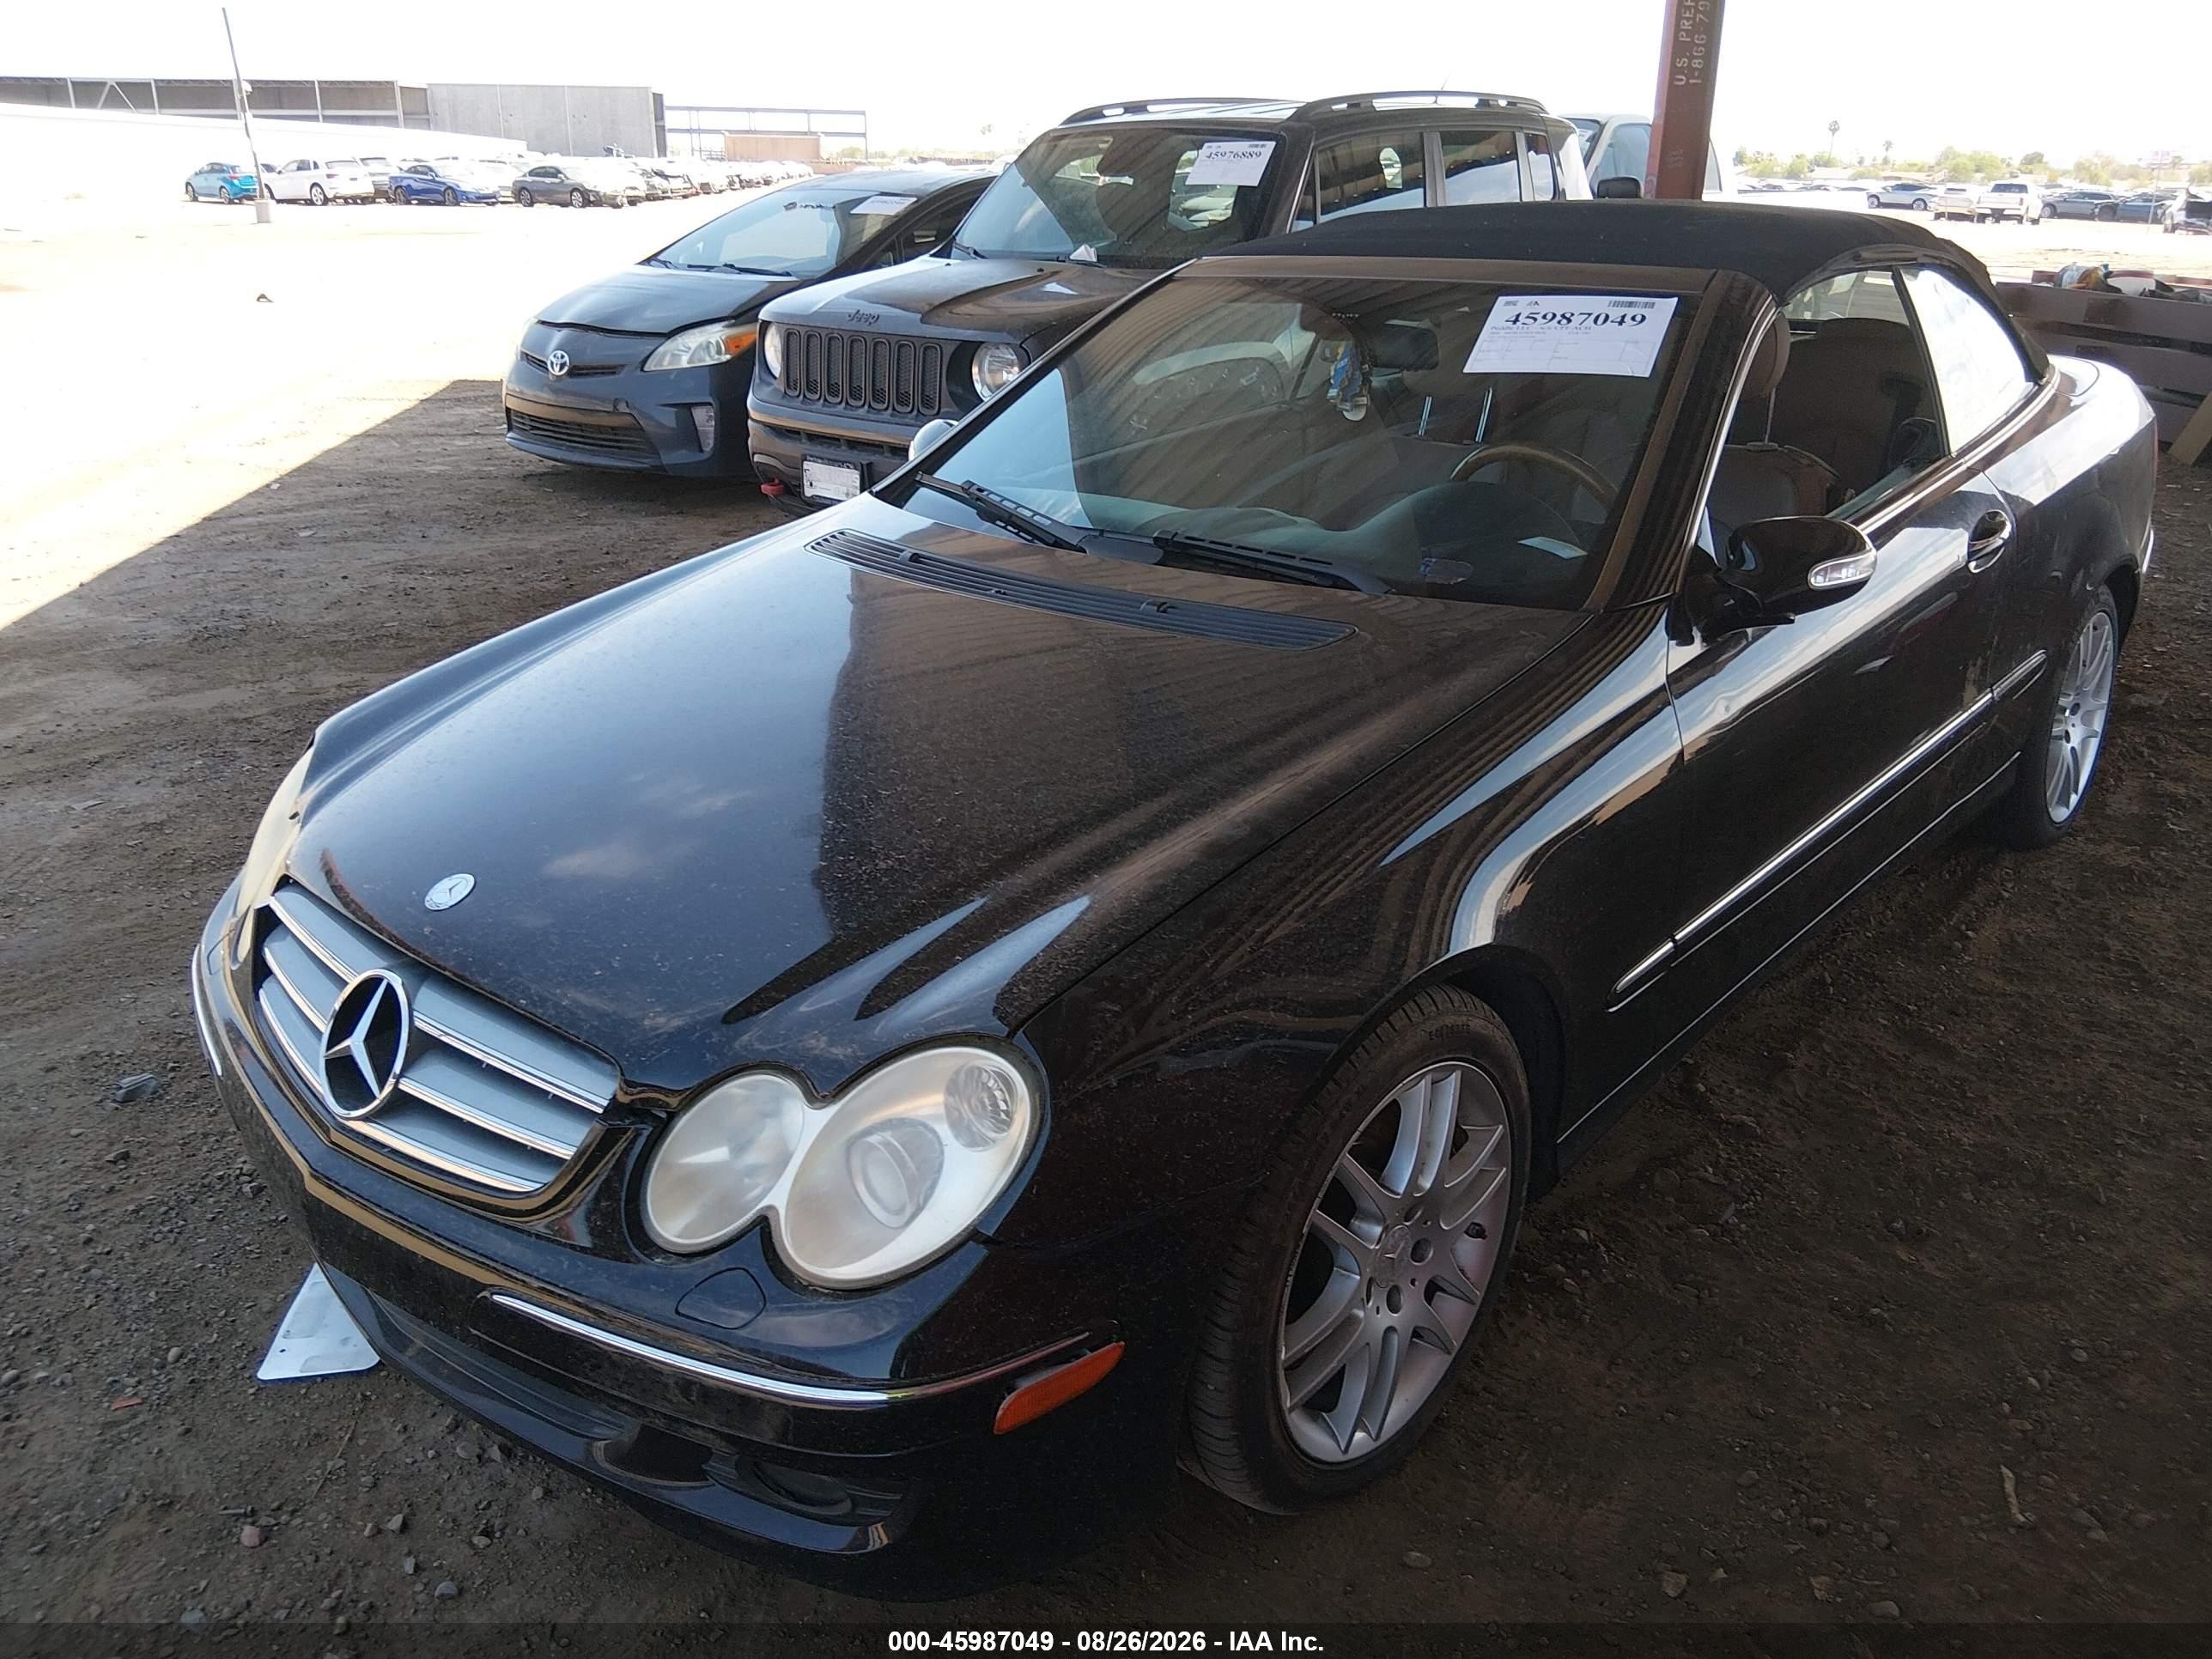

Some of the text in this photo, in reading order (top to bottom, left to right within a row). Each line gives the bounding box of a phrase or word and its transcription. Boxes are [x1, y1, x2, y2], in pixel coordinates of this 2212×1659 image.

[1673, 52, 1691, 85] U.S.
[1205, 150, 1262, 160] 45976889
[848, 309, 880, 326] Jeep
[1504, 311, 1648, 327] 45987049
